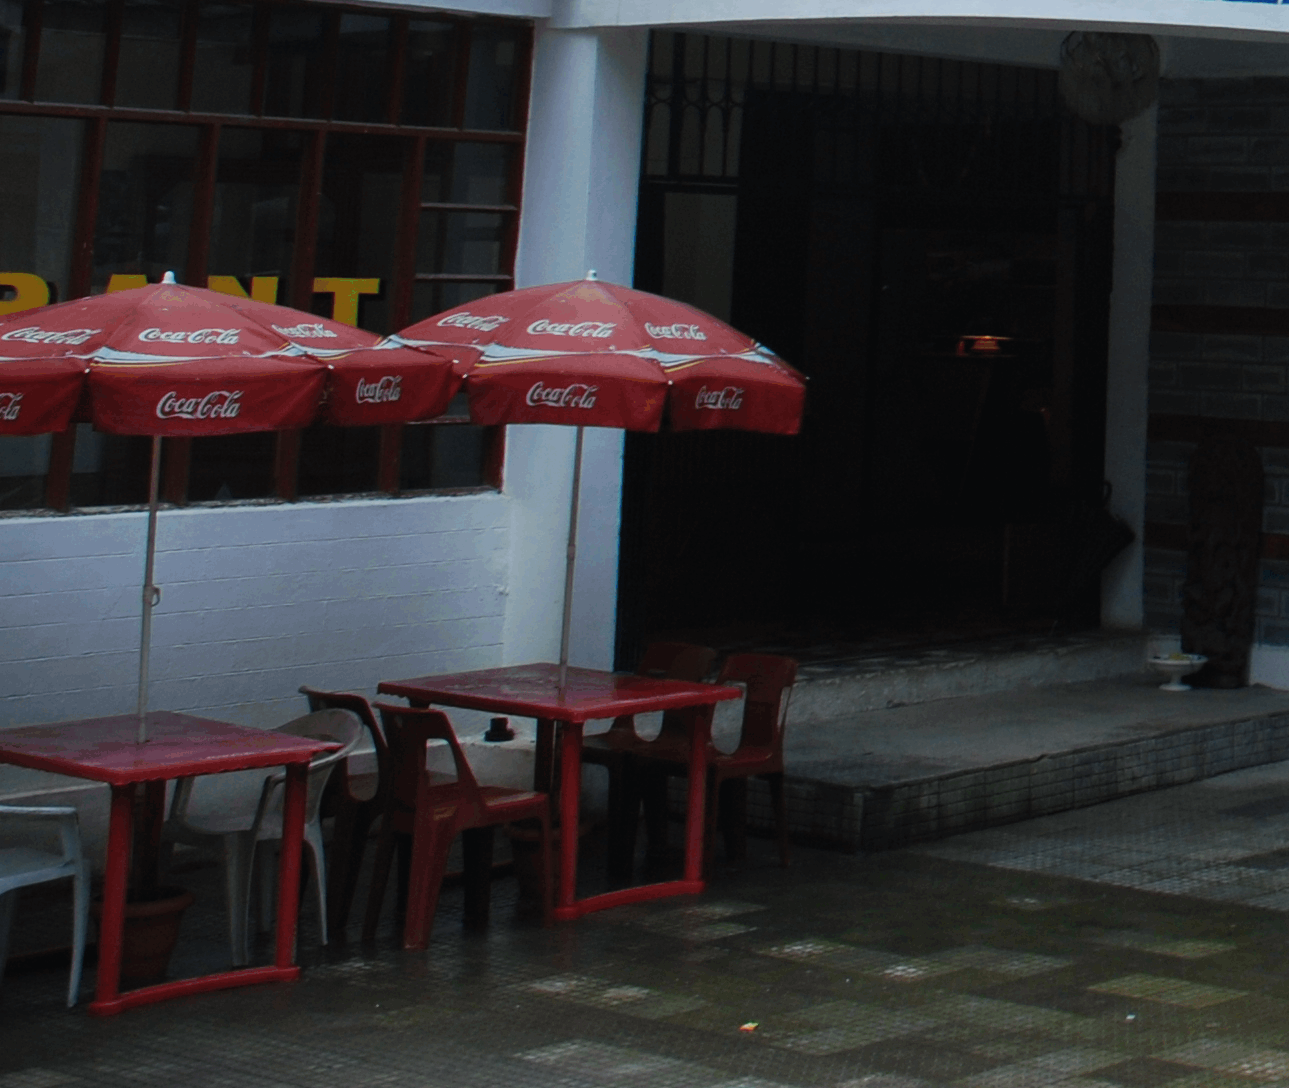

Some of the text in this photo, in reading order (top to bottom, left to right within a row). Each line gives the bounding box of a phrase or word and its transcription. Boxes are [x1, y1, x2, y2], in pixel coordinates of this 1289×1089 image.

[138, 328, 241, 344] Coca-Cola
[526, 319, 617, 338] Coca-Cola
[156, 391, 244, 419] Coca-Cola
[525, 381, 599, 409] Coca-Cola
